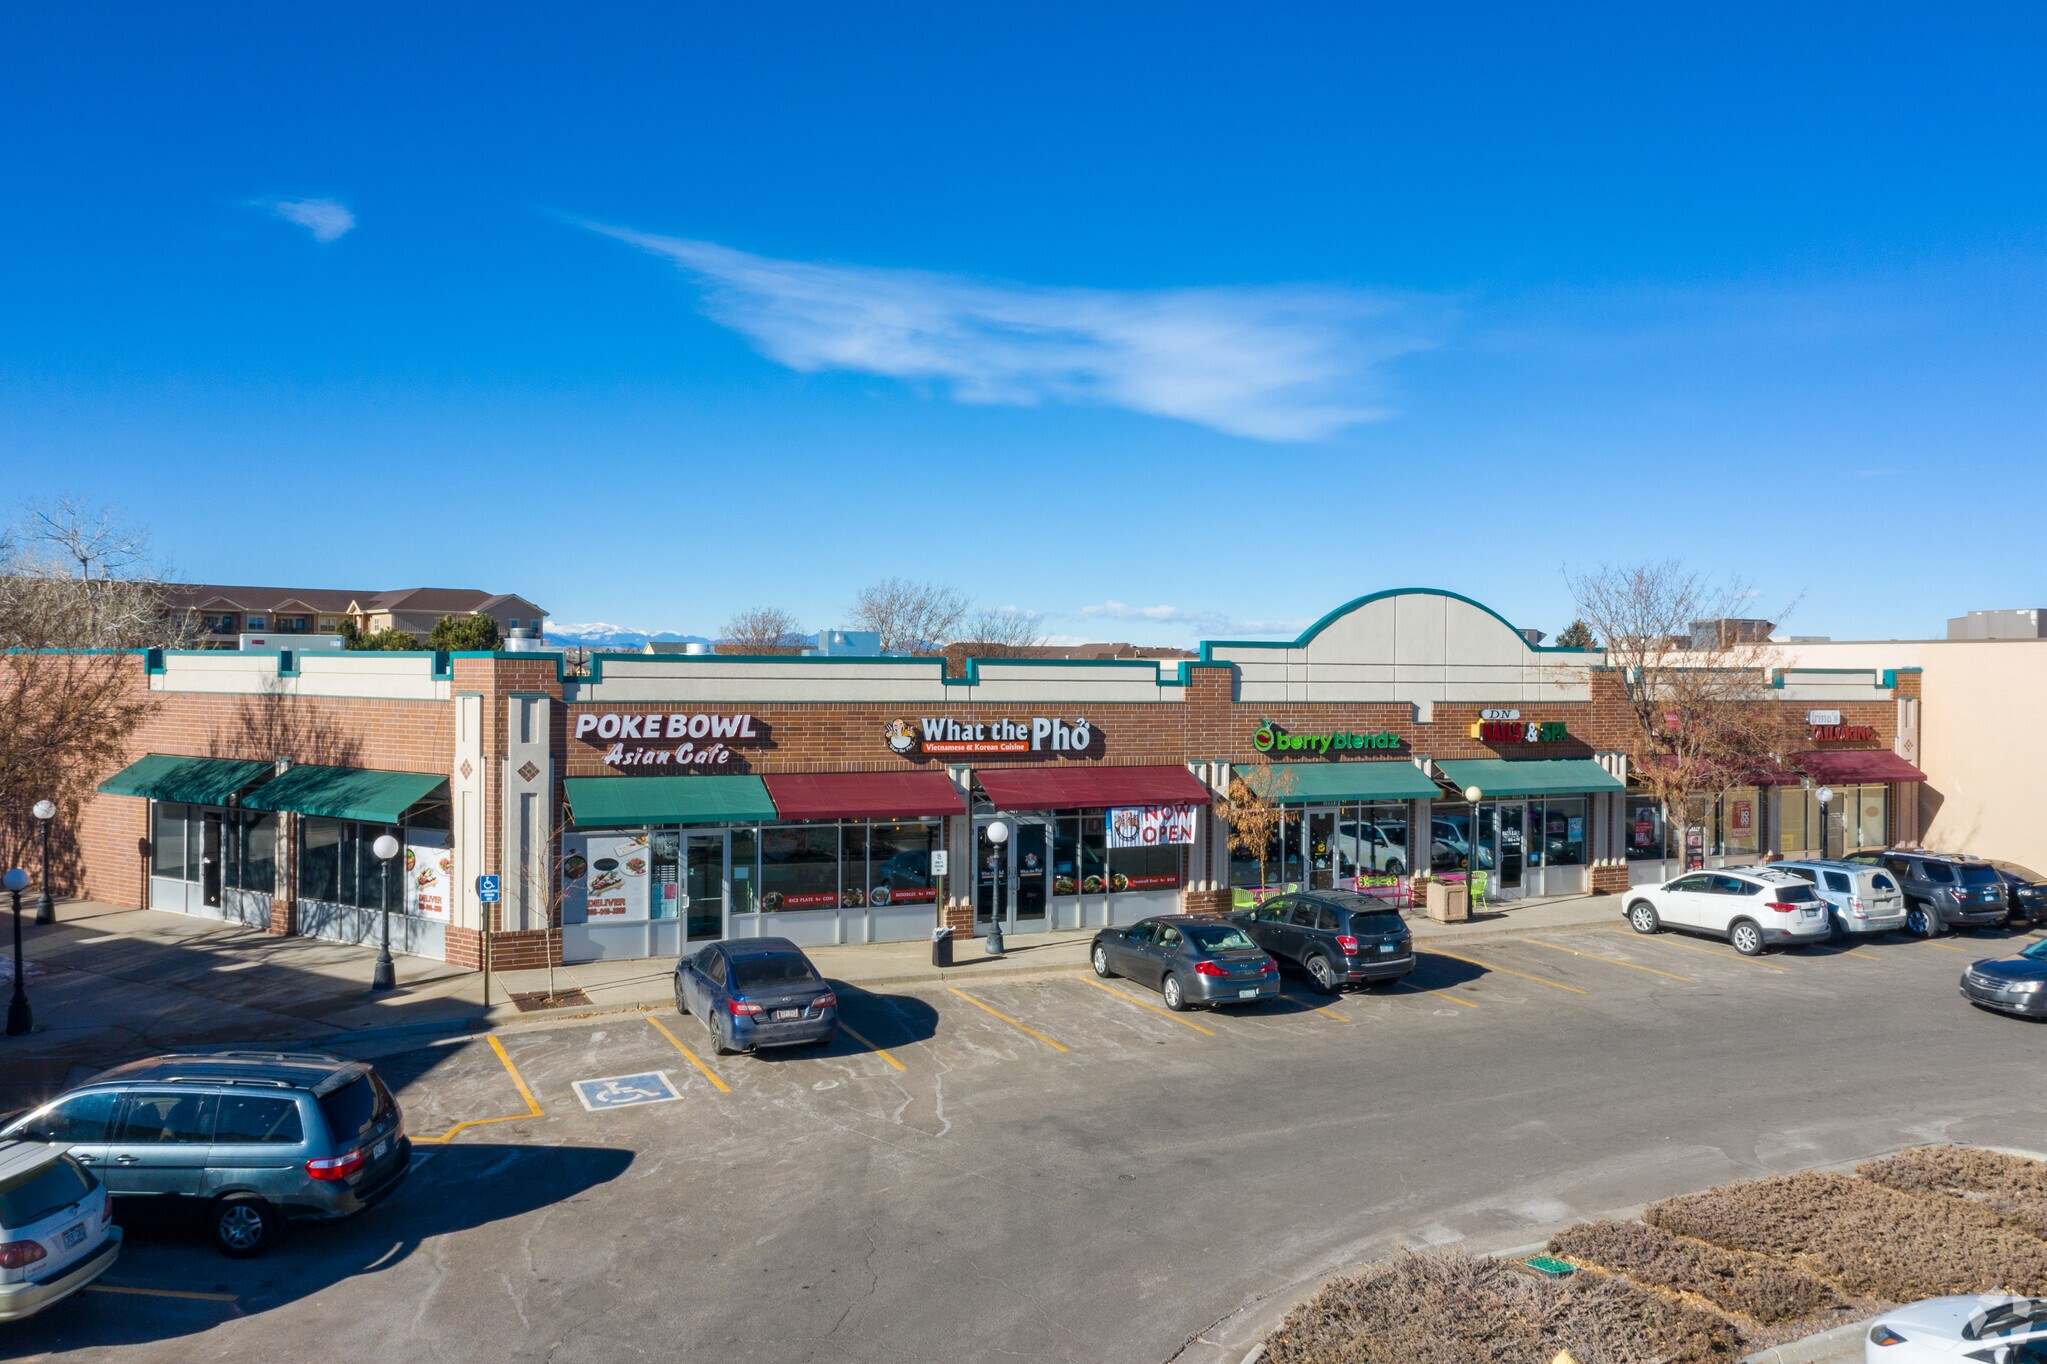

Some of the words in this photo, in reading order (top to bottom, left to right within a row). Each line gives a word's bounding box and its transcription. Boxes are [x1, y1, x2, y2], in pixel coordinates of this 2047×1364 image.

[1490, 710, 1512, 719] DN
[575, 714, 662, 739] POKE
[665, 714, 757, 738] BOWL
[921, 717, 984, 741] What
[990, 718, 1028, 741] the
[1483, 722, 1522, 742] NAILS
[1527, 722, 1538, 742] &
[1542, 722, 1567, 742] SPA
[1811, 725, 1875, 741] TAILORING
[602, 742, 671, 766] Asian
[675, 742, 730, 765] Cafe
[926, 743, 965, 751] Vietnamese
[974, 743, 998, 751] Korean
[1000, 743, 1024, 751] Cuisine
[1144, 805, 1191, 821] NOW
[1142, 825, 1192, 843] OPEN
[419, 894, 442, 904] DELIVER
[587, 897, 626, 908] DELIVER
